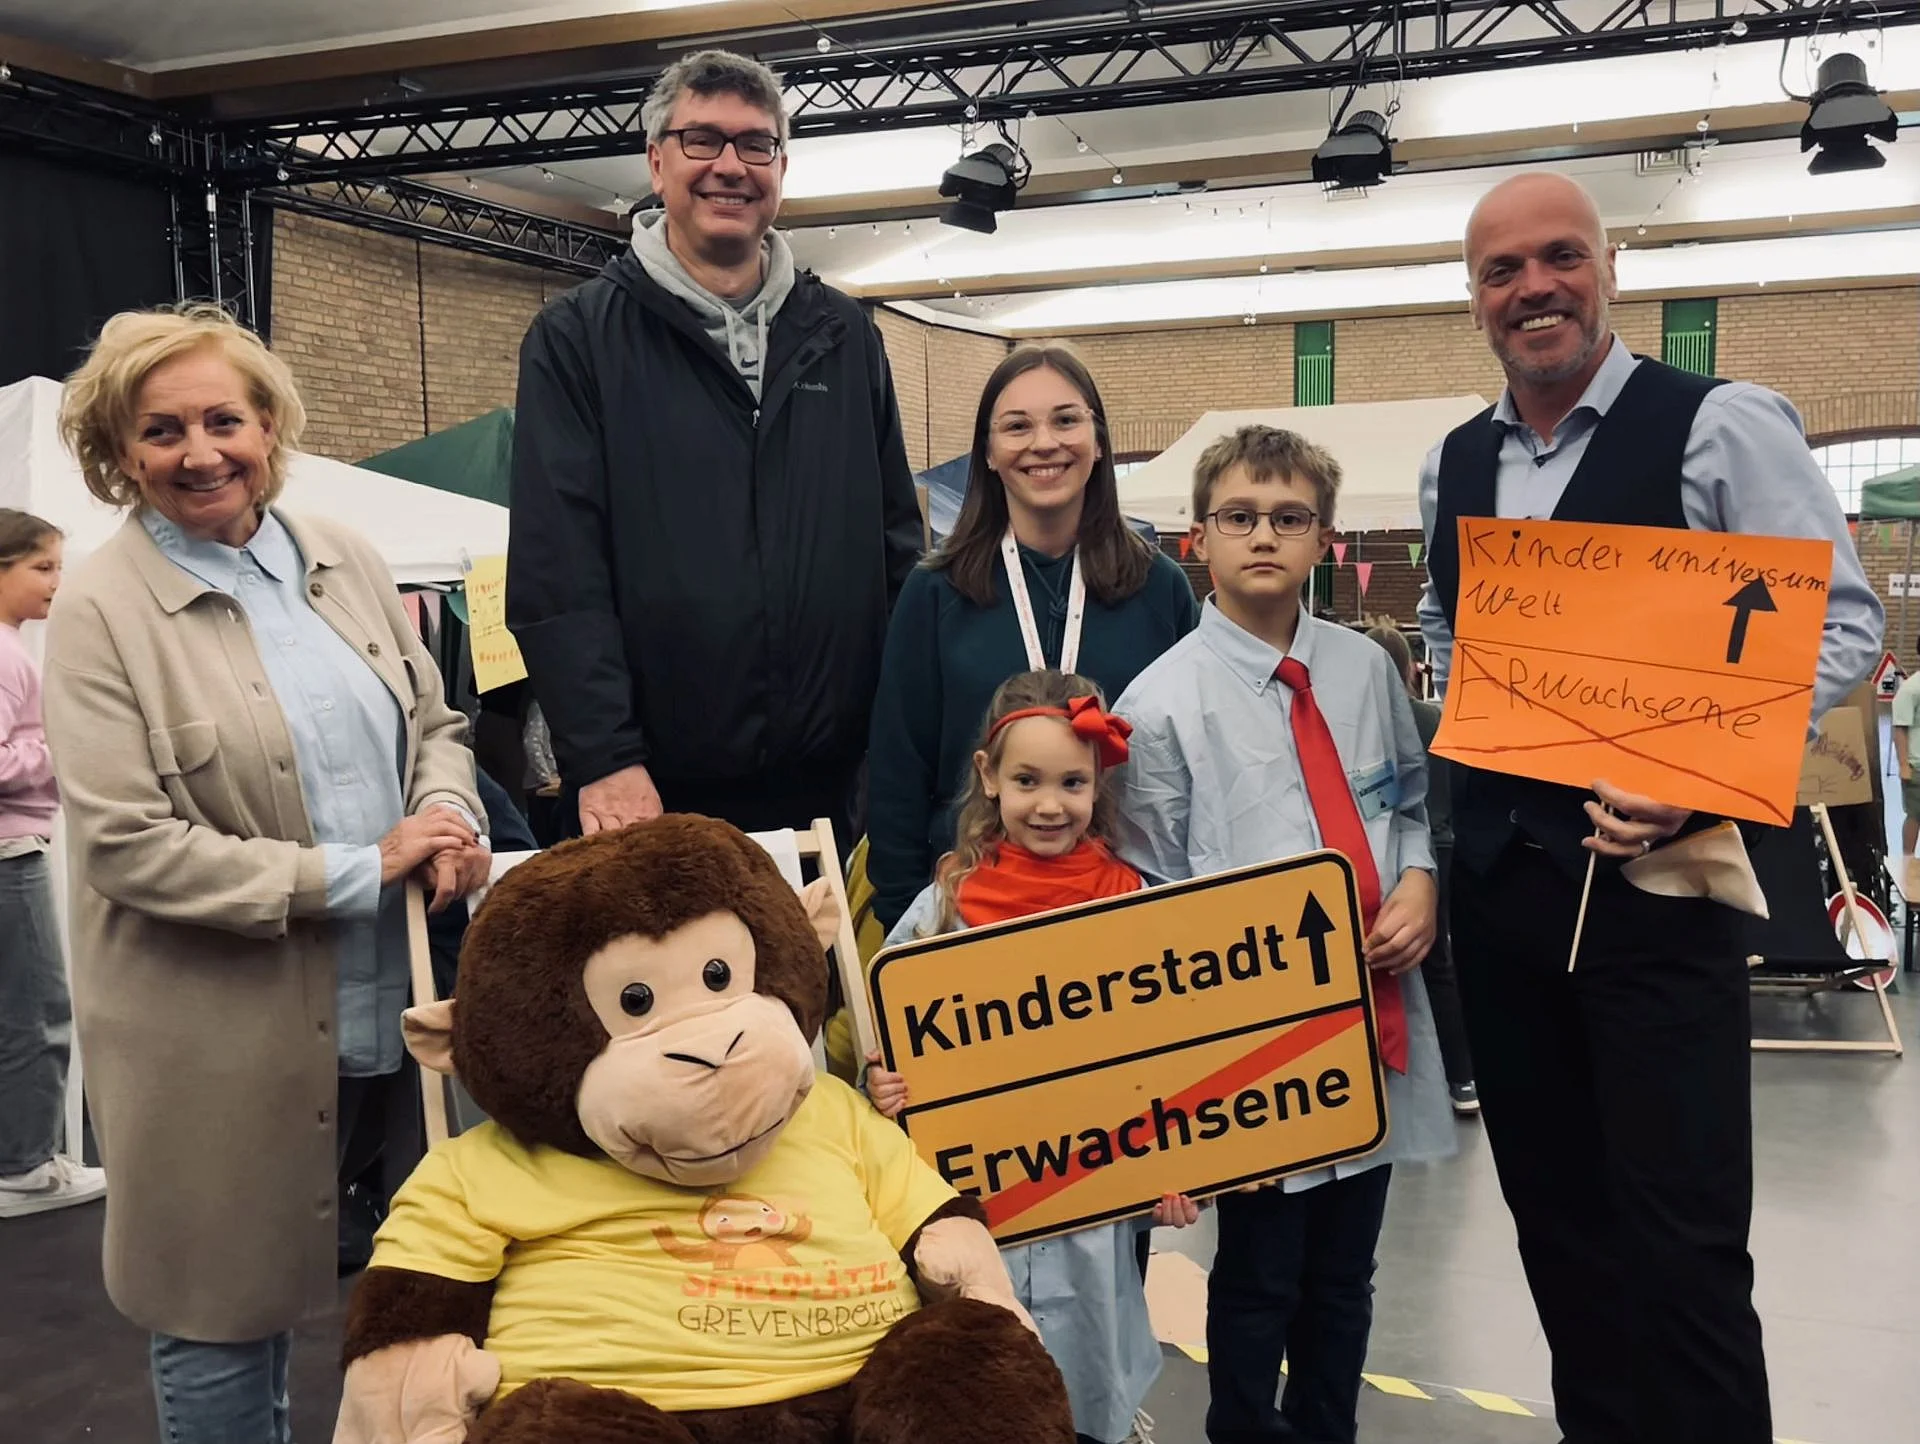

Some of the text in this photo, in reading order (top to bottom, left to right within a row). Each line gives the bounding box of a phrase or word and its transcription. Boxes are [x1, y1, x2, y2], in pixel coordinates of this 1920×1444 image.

[1465, 522, 1623, 571] Kinder
[1465, 579, 1563, 619] Welt
[903, 924, 1289, 1058] Kinderstadt
[935, 1067, 1352, 1197] Erwachsene
[677, 1298, 904, 1338] GREVENBROICH
